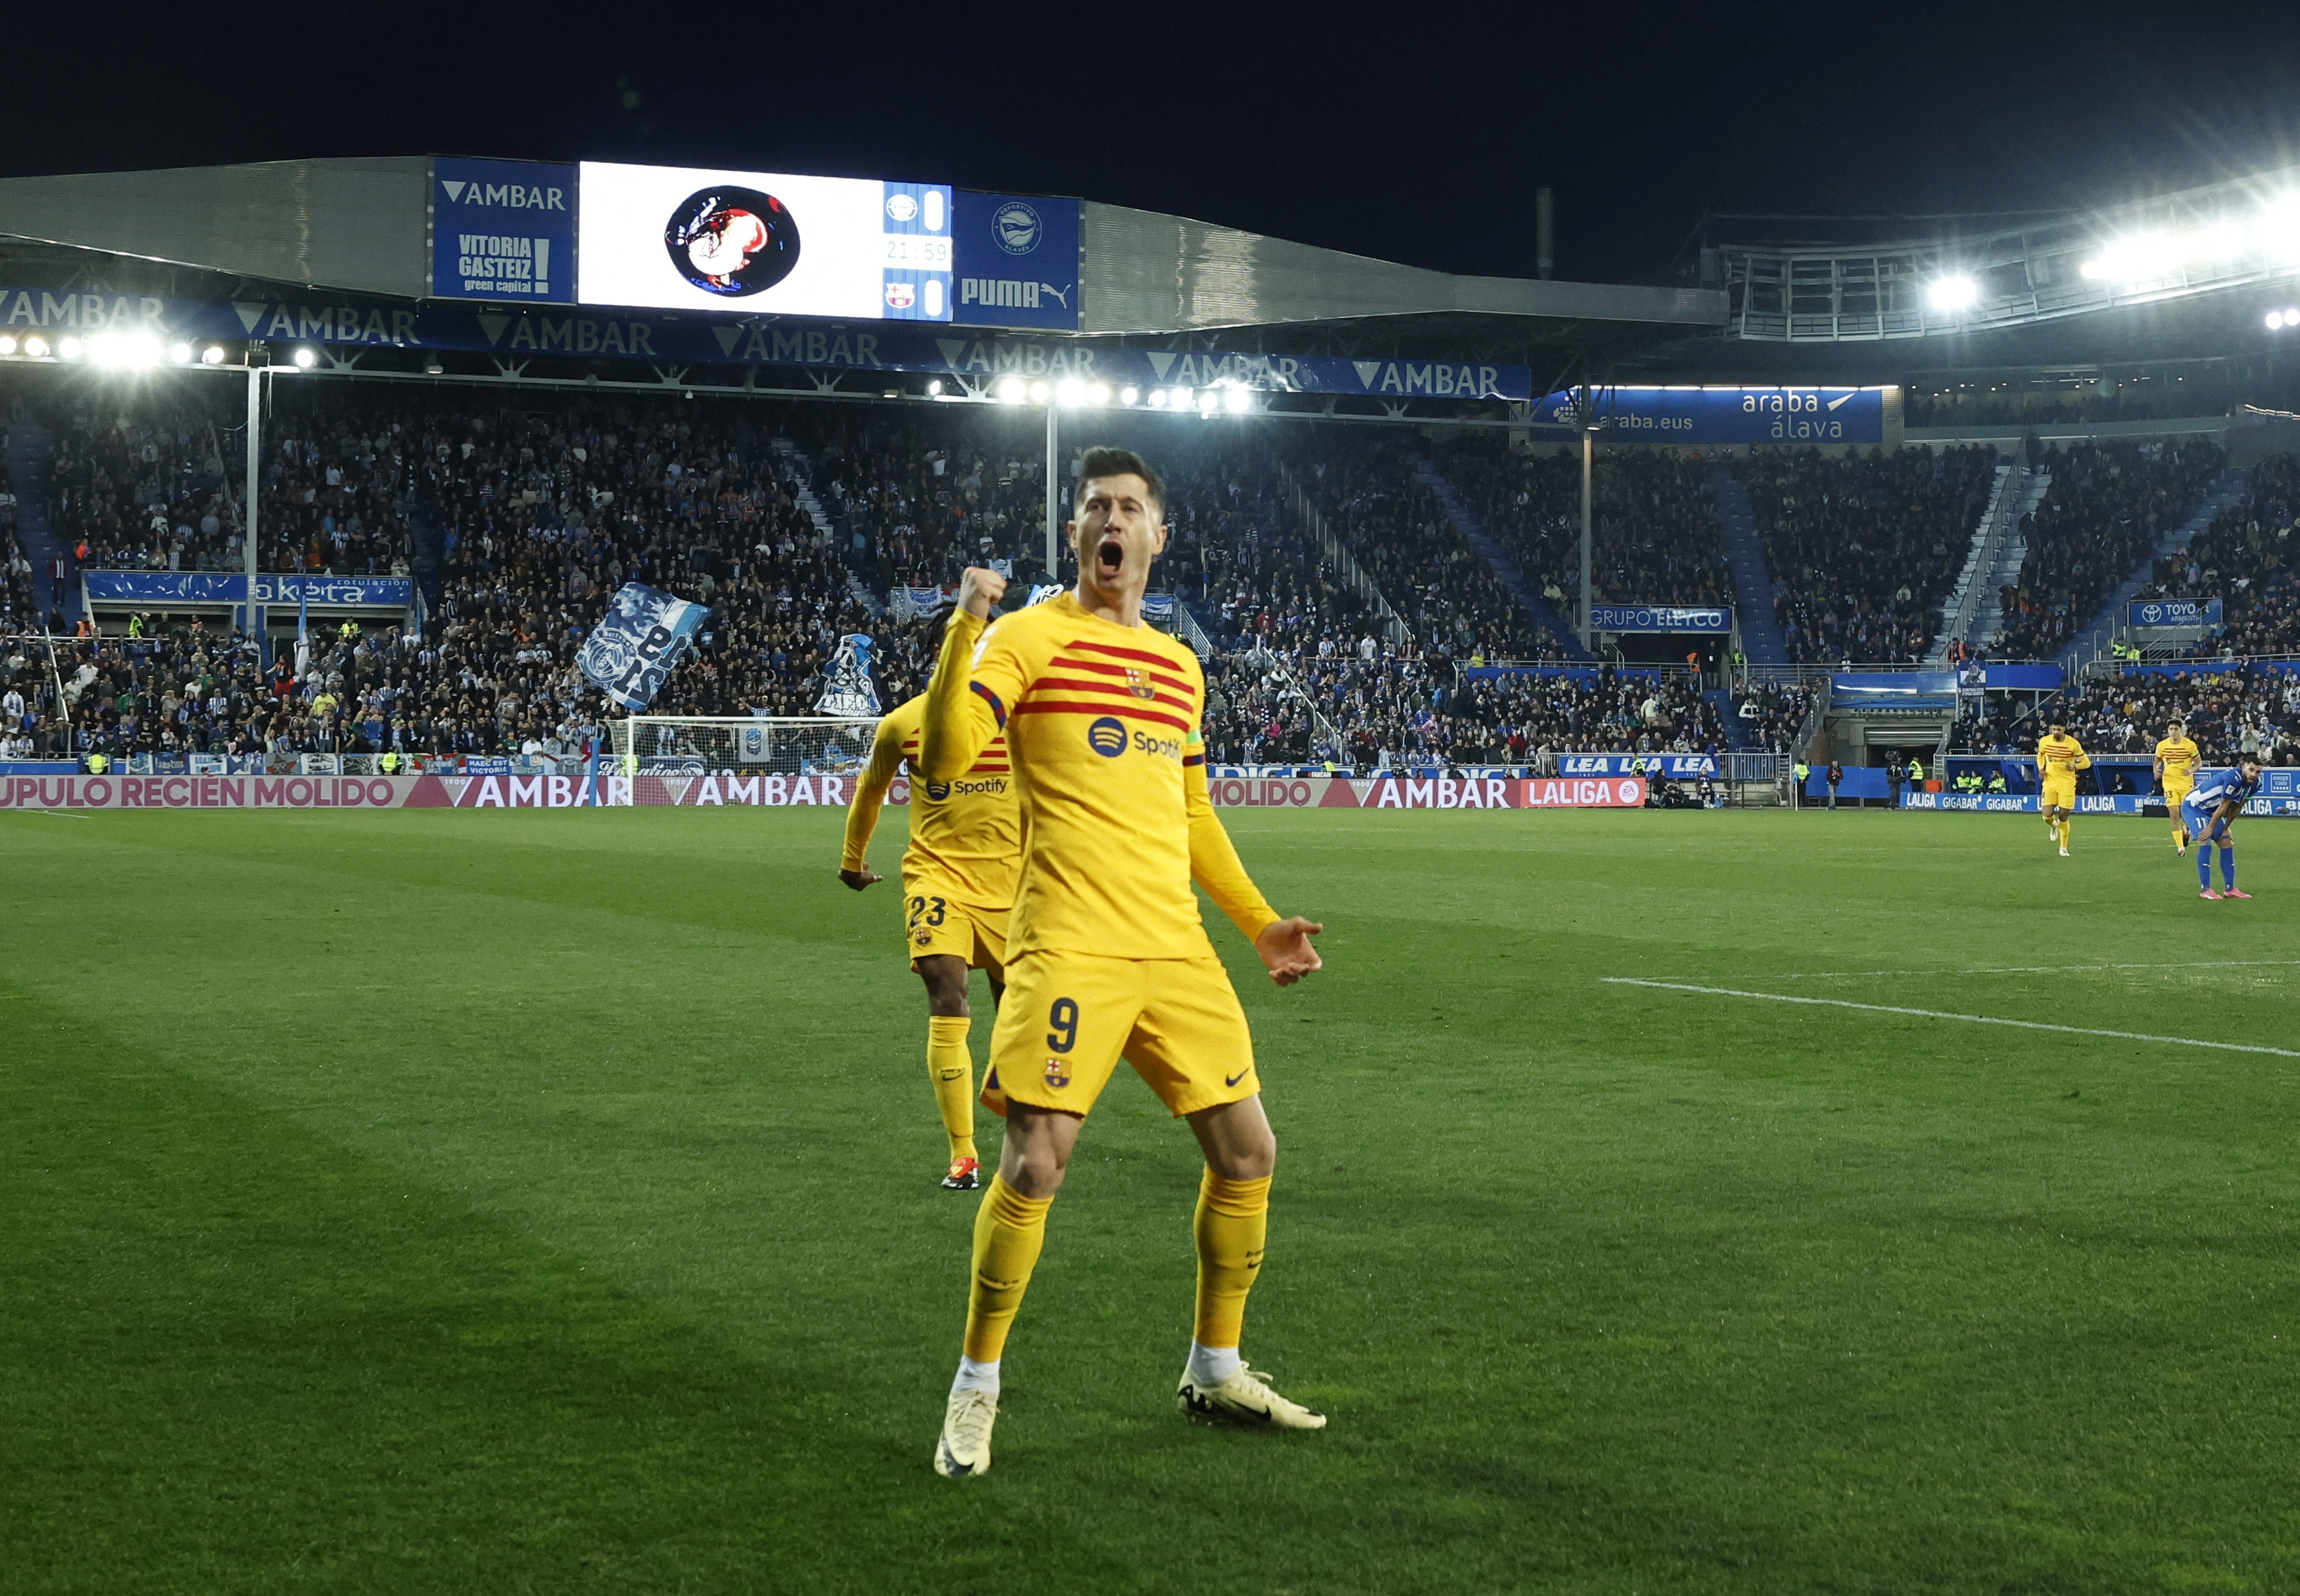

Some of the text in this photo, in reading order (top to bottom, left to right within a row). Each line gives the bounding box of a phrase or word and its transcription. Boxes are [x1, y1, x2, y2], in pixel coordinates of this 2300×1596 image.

[464, 182, 566, 210] AMBAR
[459, 234, 532, 258] VITORIA
[887, 240, 947, 261] 21:59
[459, 256, 532, 279] GASTEIZ
[464, 280, 531, 293] green capital
[962, 278, 1039, 308] PUMA
[7, 292, 170, 332] AMBAR
[267, 302, 421, 345] AMBAR
[510, 316, 655, 356] AMBAR
[743, 328, 882, 366] AMBAR
[965, 340, 1099, 379] AMBAR
[1176, 353, 1303, 391] AMBAR
[1380, 362, 1504, 396] AMBAR
[1742, 389, 1818, 412] araba
[1771, 415, 1842, 438] álava
[255, 576, 365, 603] oketa
[1591, 609, 1651, 626] GRUPO
[1564, 758, 1608, 772] LEA
[1672, 758, 1715, 772] LEA
[121, 774, 244, 807] RECIÉN
[254, 778, 394, 806] MOLIDO
[475, 775, 634, 808] AMBAR
[696, 776, 847, 806] AMBAR
[955, 778, 1007, 795] Spotify
[1377, 779, 1512, 808] AMBAR
[1529, 781, 1612, 805] LALIGA
[1907, 793, 1936, 807] LALIGA
[1943, 796, 1977, 809] GIGABAR
[1986, 798, 2022, 810] GIGABAR
[2082, 796, 2115, 811] LALIGA
[2241, 799, 2272, 815] ALIGA
[910, 896, 945, 928] 23
[1047, 997, 1078, 1054] 9
